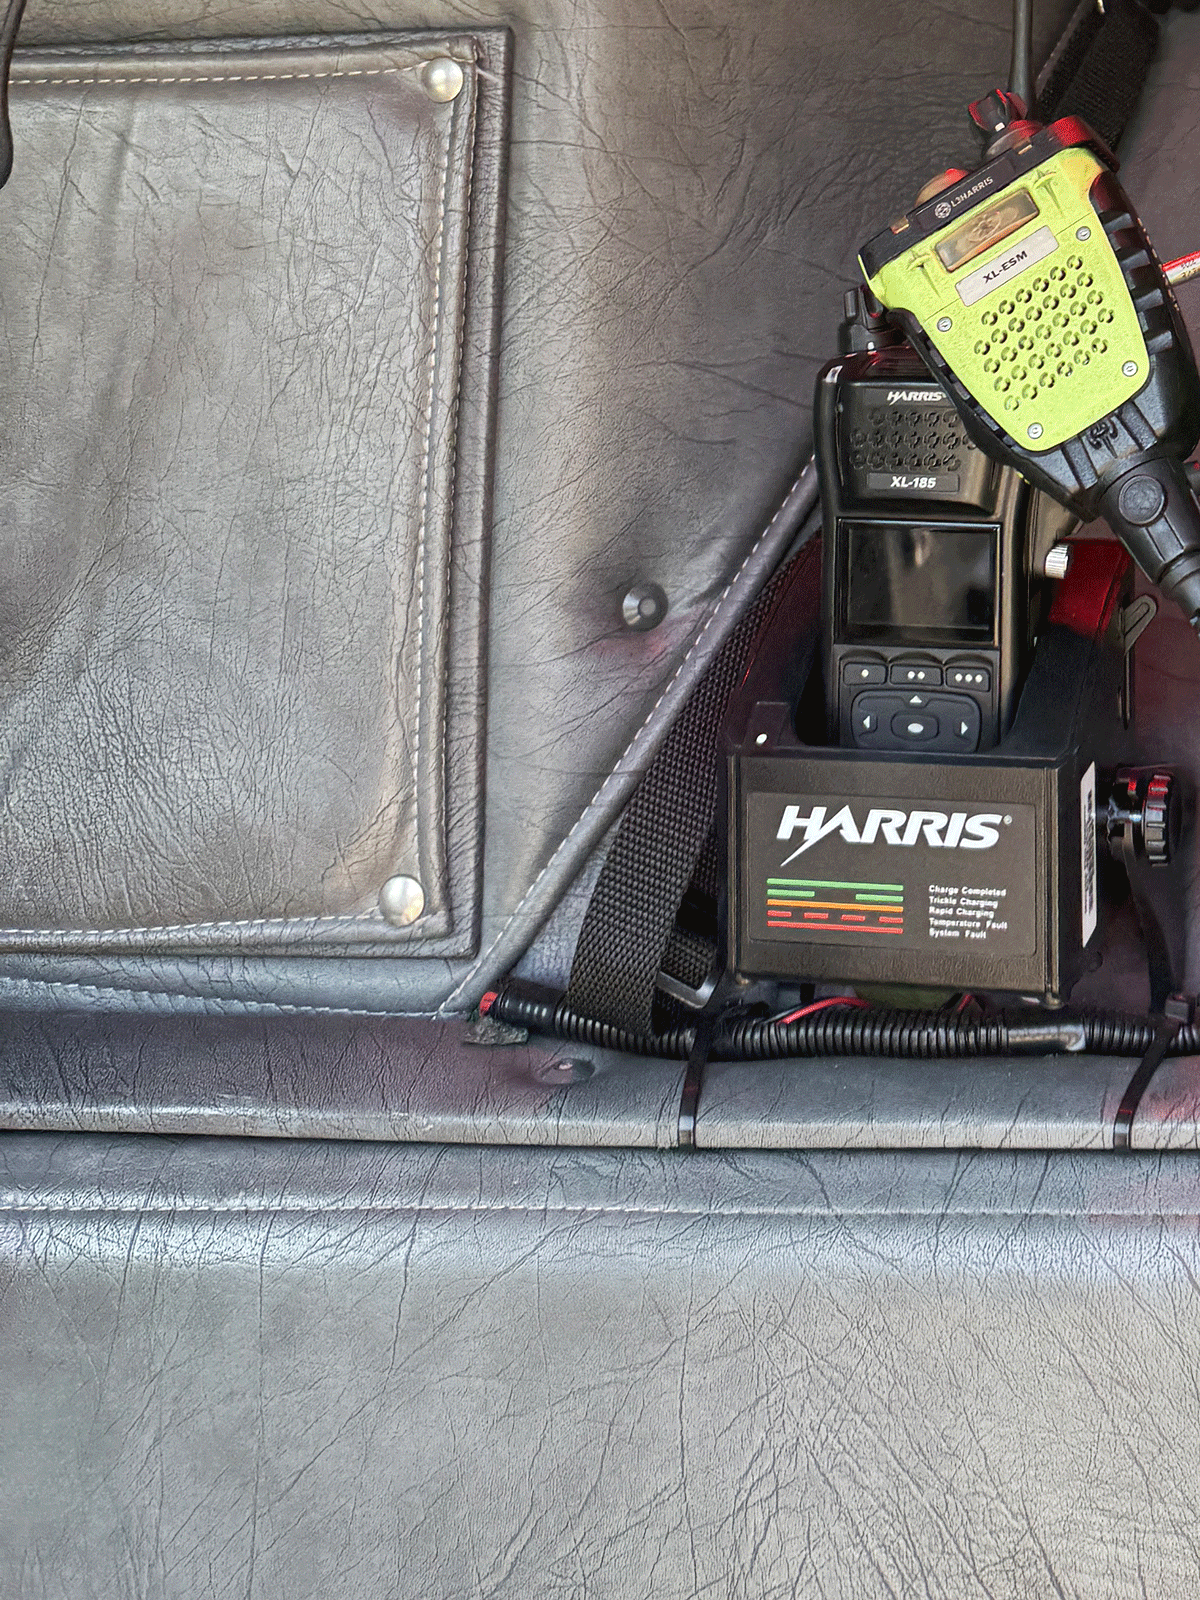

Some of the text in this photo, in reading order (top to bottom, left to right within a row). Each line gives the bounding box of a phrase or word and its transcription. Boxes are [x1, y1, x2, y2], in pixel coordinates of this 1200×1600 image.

[950, 175, 994, 209] L3HARRIS
[982, 249, 1029, 284] XL-ESM
[890, 475, 937, 489] XL-185
[928, 884, 1007, 897] Charge Completed
[929, 895, 998, 909] Trickle Charging
[929, 905, 995, 919] Rapid Charging
[929, 917, 1008, 930] Temperature Fault
[929, 927, 987, 939] System Fault
